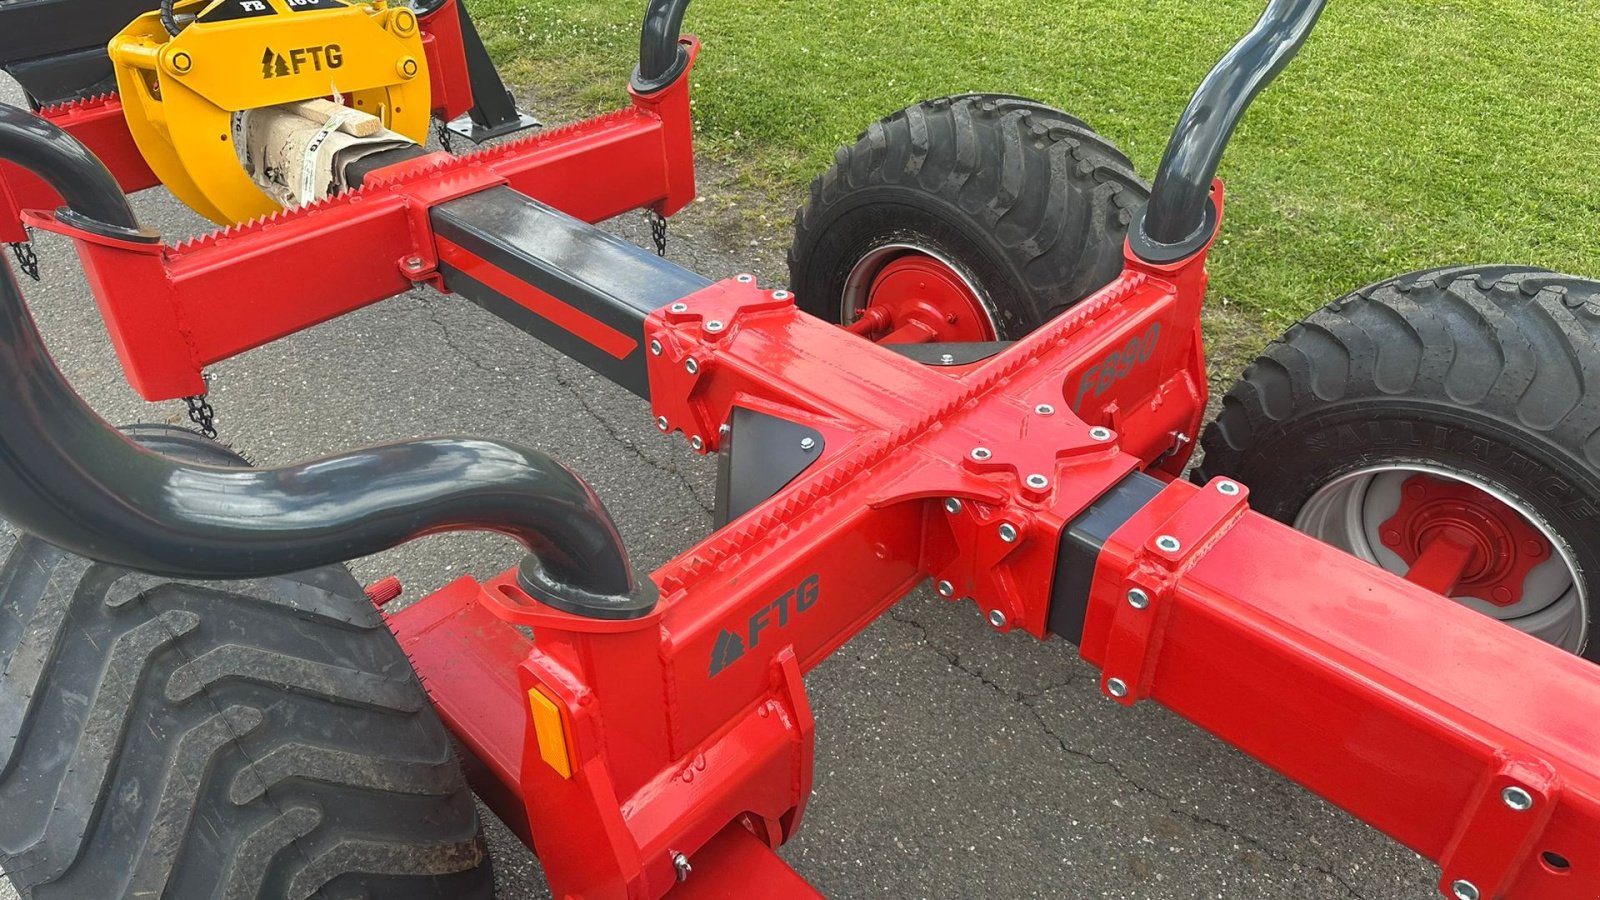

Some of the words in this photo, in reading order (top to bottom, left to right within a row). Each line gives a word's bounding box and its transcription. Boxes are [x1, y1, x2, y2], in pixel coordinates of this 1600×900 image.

[240, 1, 266, 11] FB
[289, 44, 343, 74] FTG
[310, 130, 328, 152] FTG
[1073, 321, 1161, 412] FB90
[1337, 420, 1599, 521] ALLIANCE
[749, 574, 819, 650] FTG
